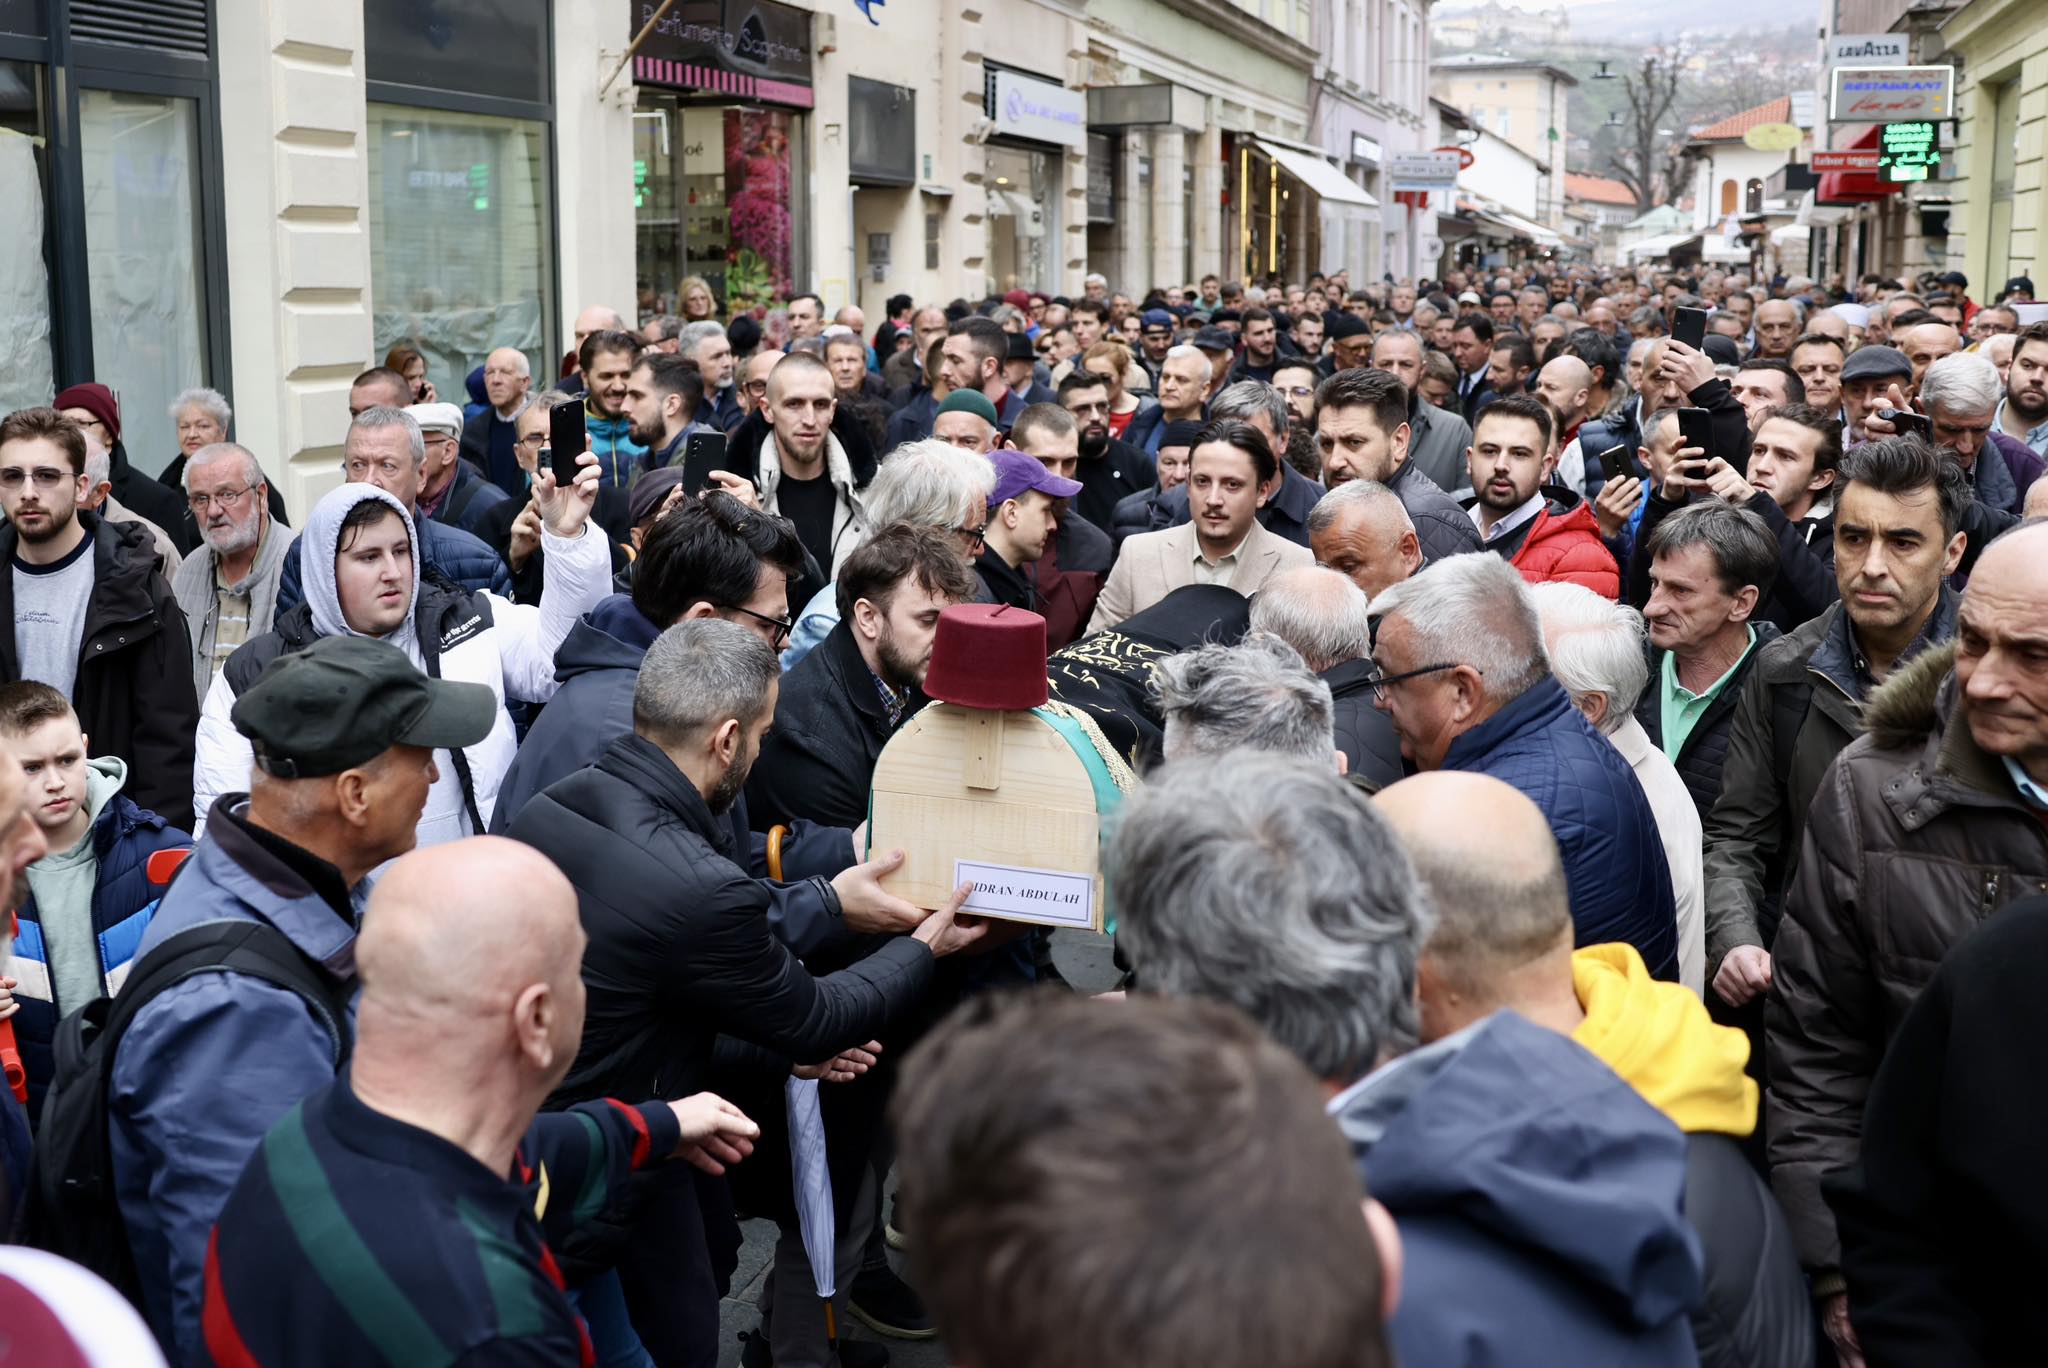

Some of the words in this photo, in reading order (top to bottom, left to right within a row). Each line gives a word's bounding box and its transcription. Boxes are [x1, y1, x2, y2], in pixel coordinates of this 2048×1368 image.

[1838, 41, 1900, 57] LAVAZZA
[973, 881, 1014, 896] IDRAN
[1016, 887, 1080, 905] ABDULAH
